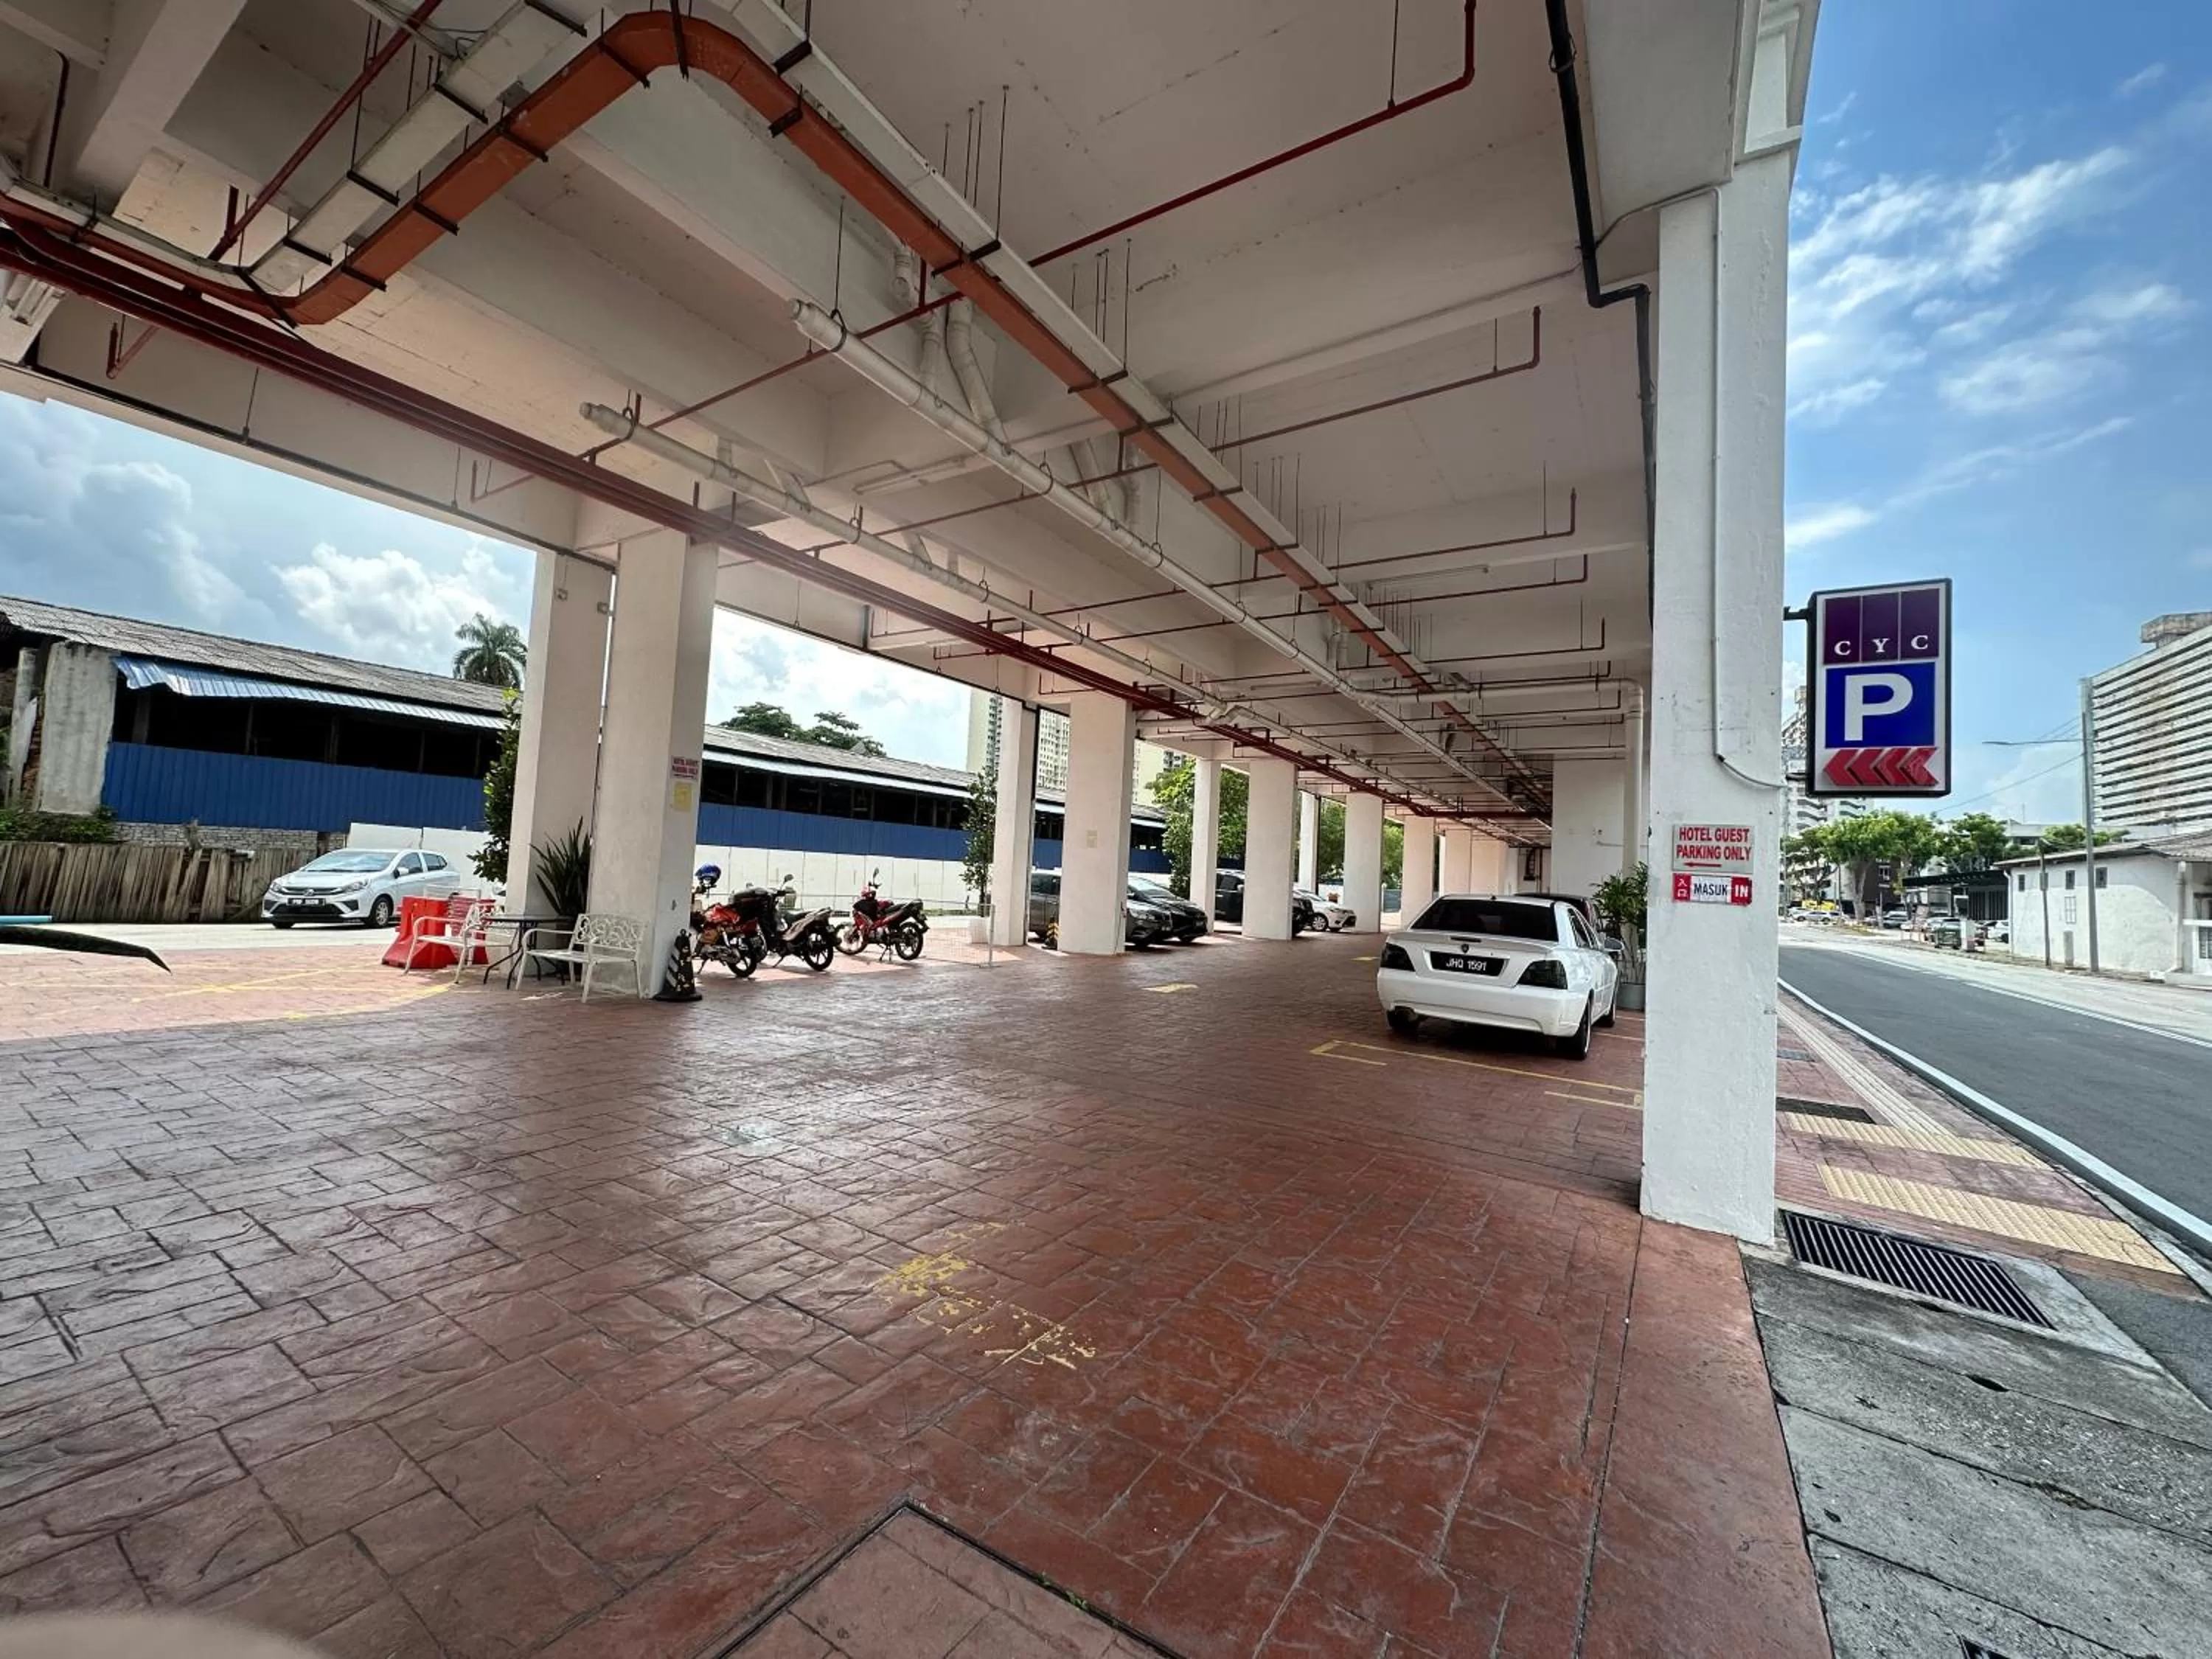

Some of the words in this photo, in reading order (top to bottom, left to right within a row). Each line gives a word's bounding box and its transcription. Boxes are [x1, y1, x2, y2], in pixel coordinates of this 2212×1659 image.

[1844, 672, 1913, 741] P
[1679, 827, 1712, 841] HOTEL
[1714, 828, 1750, 842] GUEST
[1676, 844, 1721, 859] PARKING
[1723, 846, 1751, 860] ONLY
[1694, 883, 1728, 896] MASUK
[1734, 884, 1749, 897] IN
